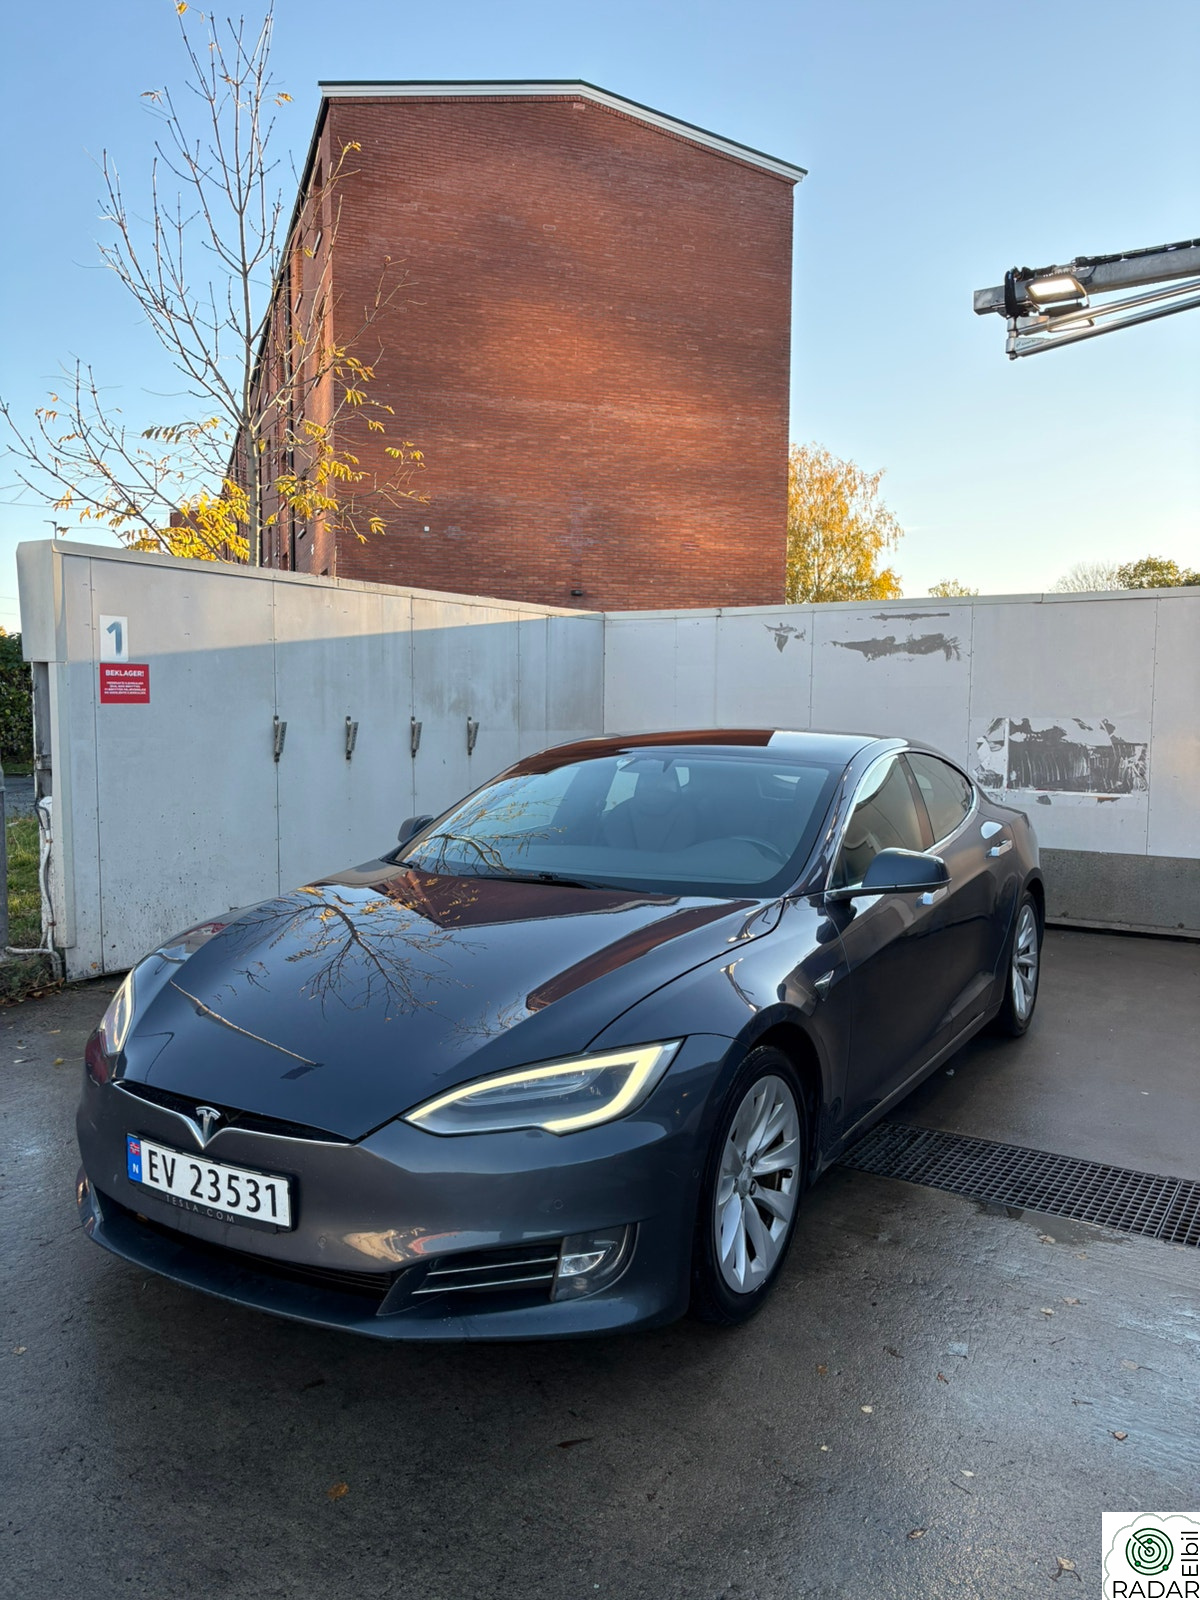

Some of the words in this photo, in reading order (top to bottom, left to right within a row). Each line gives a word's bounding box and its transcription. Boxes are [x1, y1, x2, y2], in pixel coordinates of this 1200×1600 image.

[106, 621, 122, 656] 1
[105, 669, 145, 677] BEKLAGER!
[132, 1163, 139, 1174] N
[148, 1149, 176, 1188] EV
[189, 1164, 277, 1218] 23531
[165, 1194, 235, 1223] TESLA.COM
